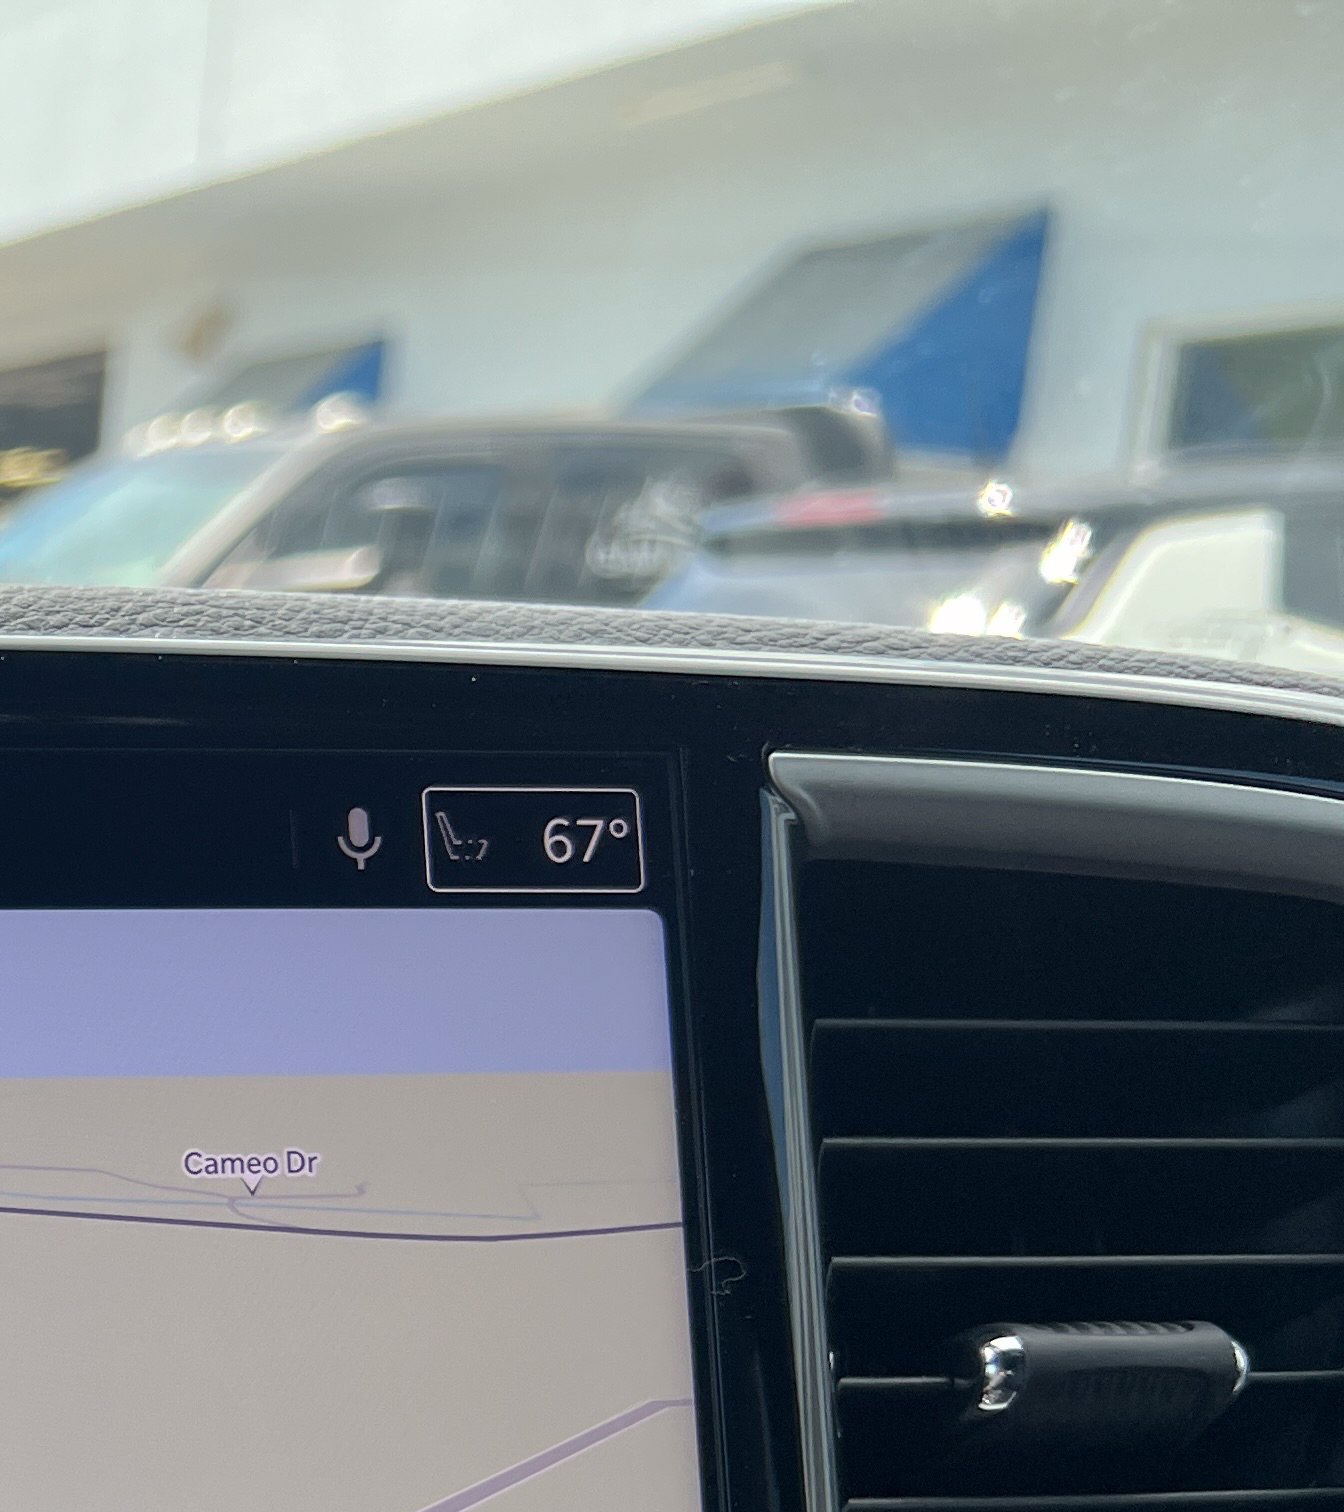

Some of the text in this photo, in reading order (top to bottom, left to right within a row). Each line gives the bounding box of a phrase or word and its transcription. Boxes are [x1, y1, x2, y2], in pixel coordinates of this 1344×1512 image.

[543, 818, 628, 864] 67°
[183, 1151, 318, 1176] Cameo Dr
